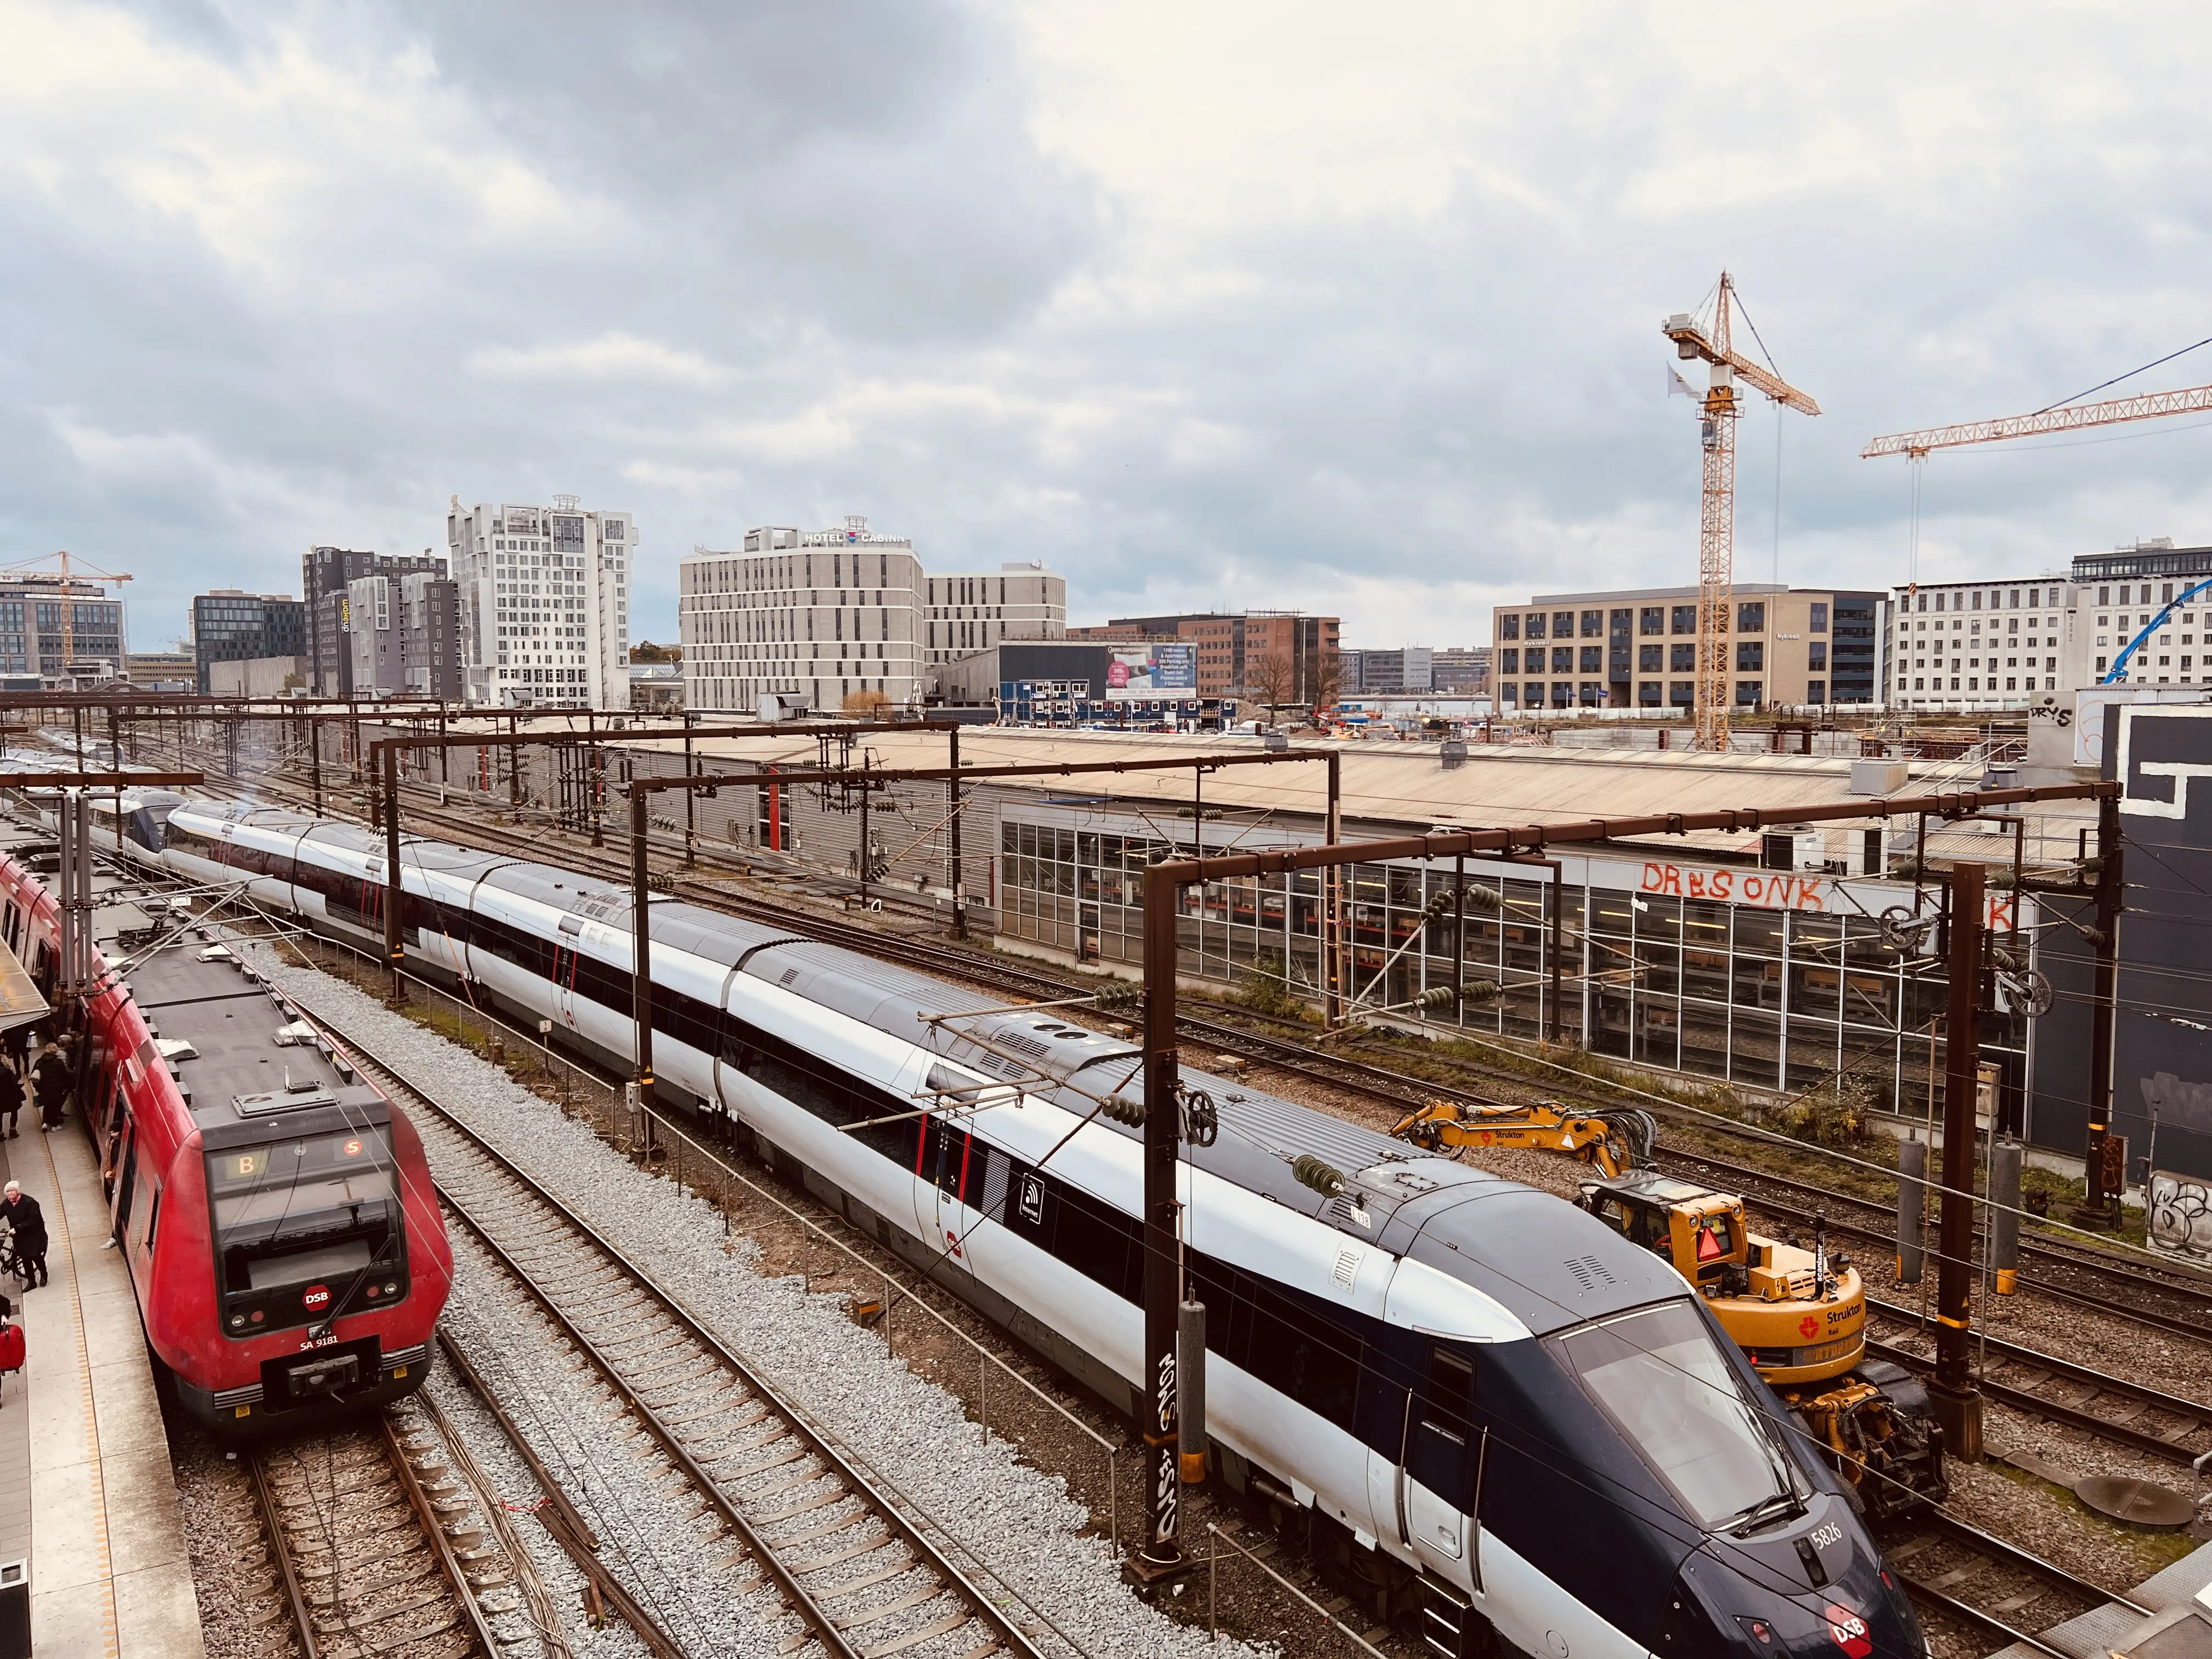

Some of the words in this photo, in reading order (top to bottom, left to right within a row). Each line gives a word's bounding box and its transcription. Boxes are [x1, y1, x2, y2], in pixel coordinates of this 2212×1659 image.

[805, 533, 843, 542] HOTEL
[861, 534, 905, 542] CABINN
[2029, 707, 2073, 727] DRYS
[1494, 1130, 1525, 1139] Strukton
[239, 1156, 254, 1174] B
[306, 1292, 328, 1304] DSB
[1827, 1304, 1861, 1324] Strukton
[300, 1341, 313, 1351] SA
[316, 1335, 338, 1347] 9181
[1811, 1521, 1842, 1550] 5826
[1832, 1618, 1865, 1644] DSB
